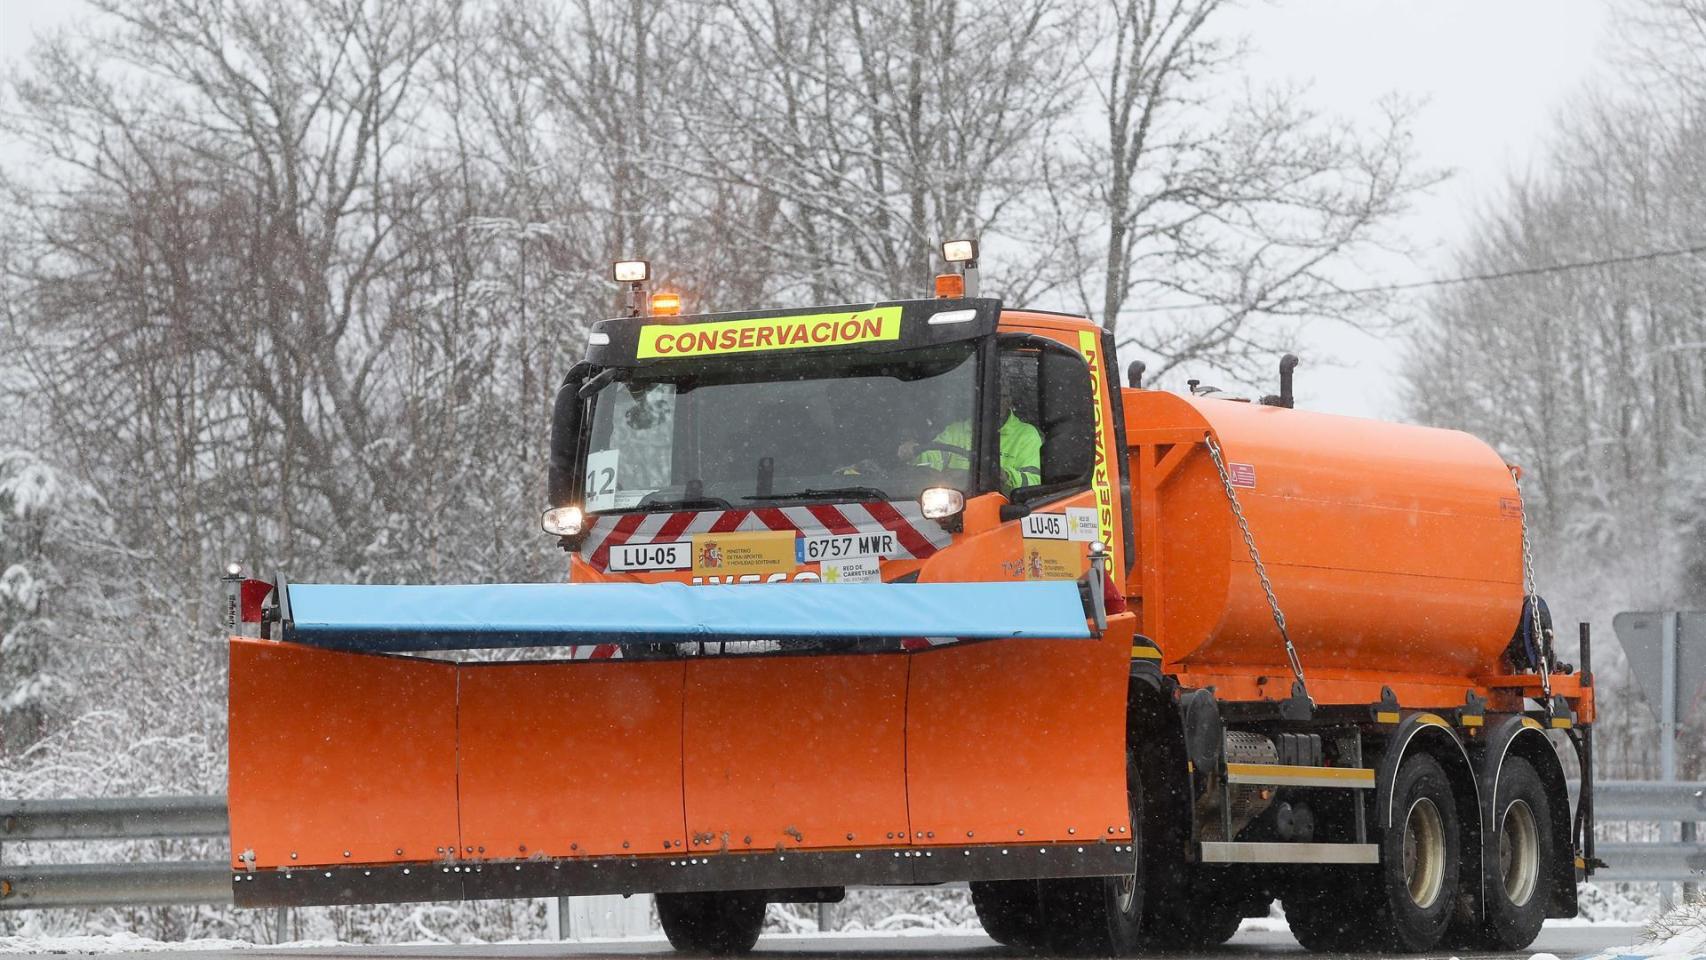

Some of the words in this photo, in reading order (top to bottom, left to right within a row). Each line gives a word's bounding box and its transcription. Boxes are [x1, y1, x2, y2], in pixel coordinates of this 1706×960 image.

[655, 315, 883, 354] CONSERVACIÓN
[586, 467, 616, 498] 12
[1030, 517, 1060, 535] LU-05
[624, 547, 677, 566] LU-05
[808, 538, 853, 558] 6757
[858, 535, 893, 554] MWR
